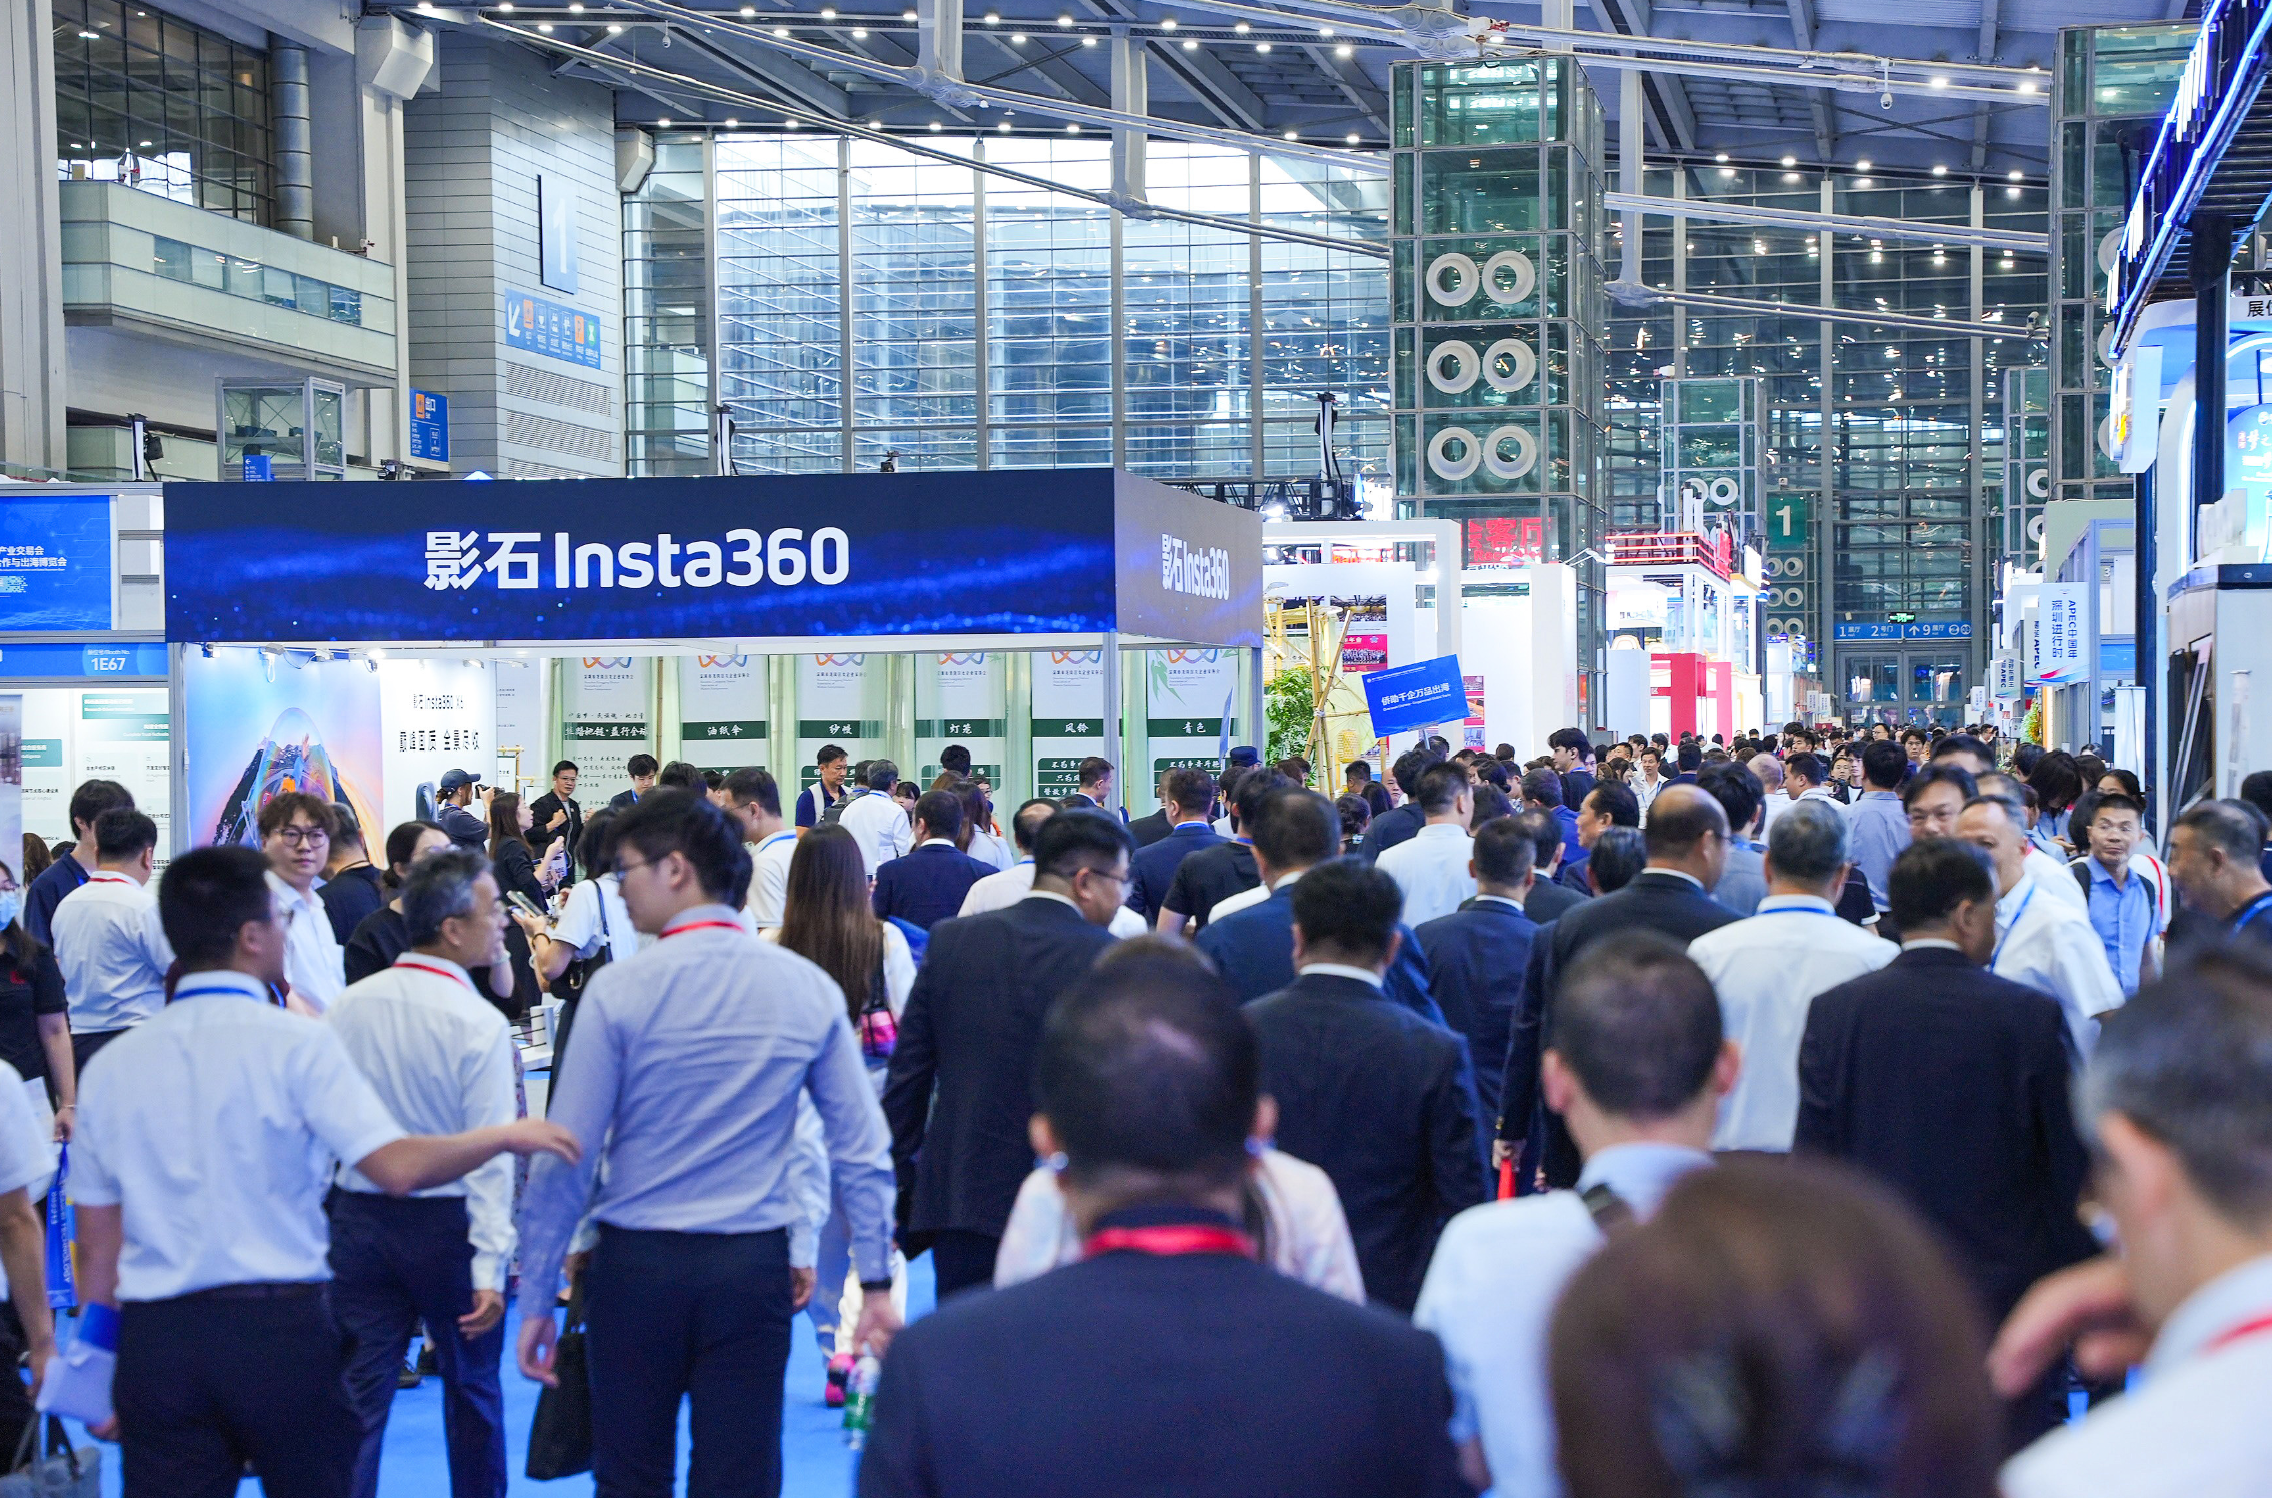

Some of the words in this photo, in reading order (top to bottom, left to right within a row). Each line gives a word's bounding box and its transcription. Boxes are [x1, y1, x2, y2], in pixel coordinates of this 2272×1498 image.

[553, 198, 567, 274] 1
[1776, 505, 1790, 536] 1
[424, 530, 541, 590] 影石
[555, 527, 849, 589] Insta360
[1162, 533, 1184, 591] 影石
[1184, 541, 1230, 600] Insta360
[1840, 626, 1847, 637] 1
[1871, 625, 1879, 637] 2
[1923, 624, 1931, 636] 9
[91, 657, 126, 671] 1E67
[1381, 683, 1450, 706] 侨助千企万品出海
[707, 724, 743, 737] 油纸伞
[949, 723, 973, 735] 灯笼
[1064, 722, 1089, 734] 风铃
[1182, 721, 1207, 734] 青色
